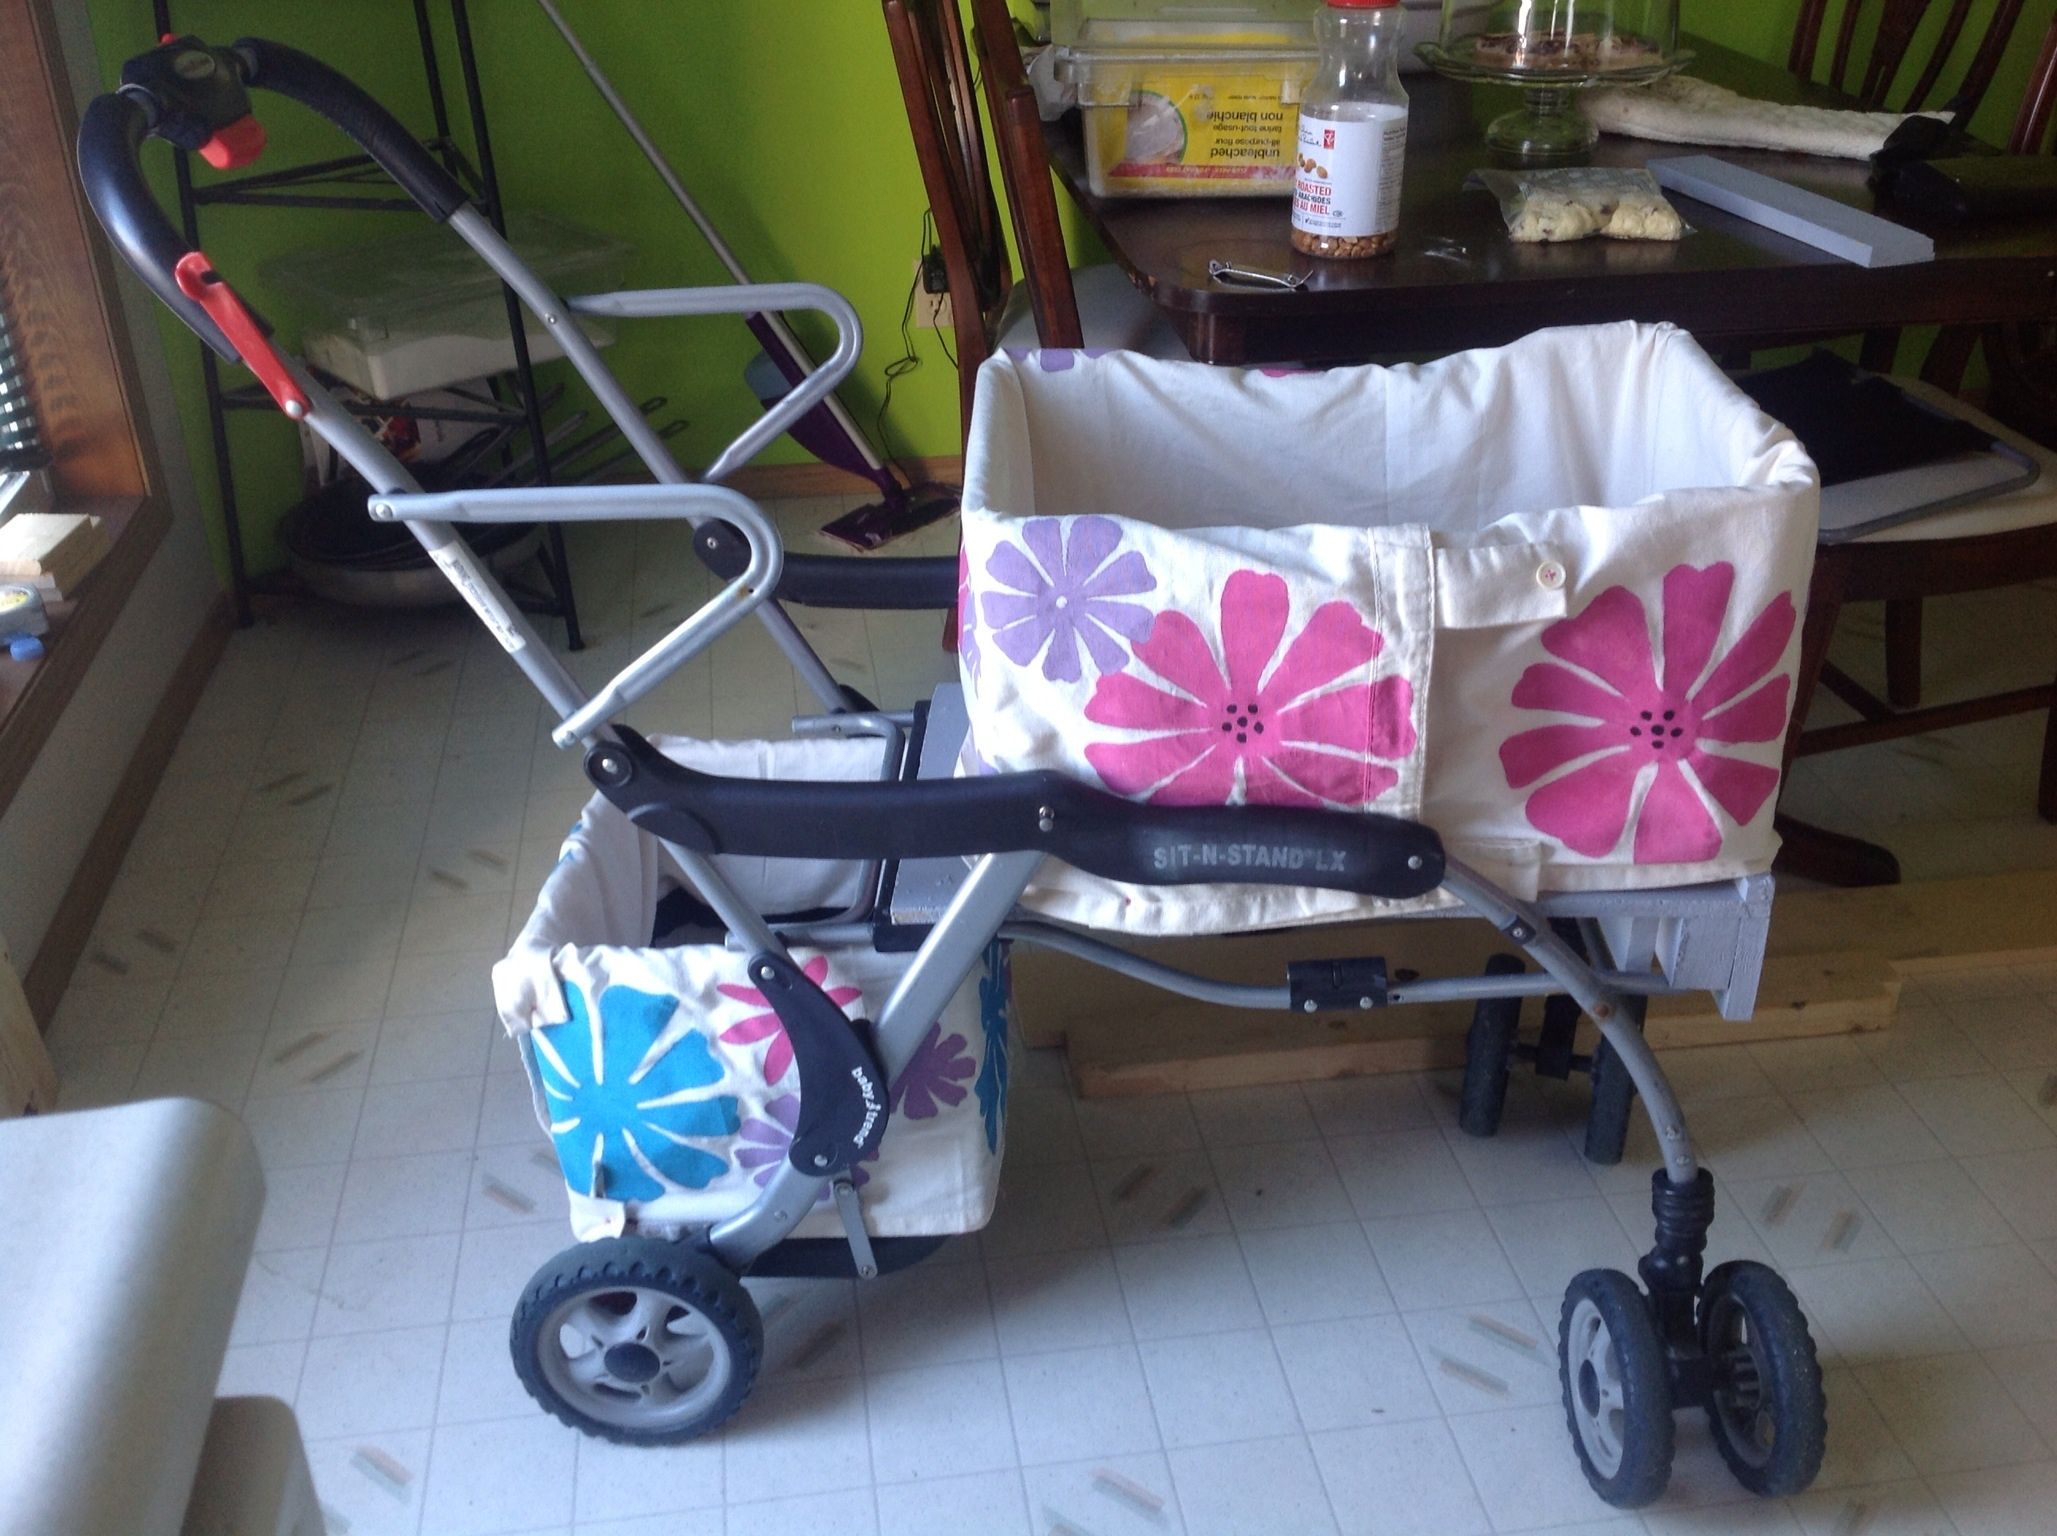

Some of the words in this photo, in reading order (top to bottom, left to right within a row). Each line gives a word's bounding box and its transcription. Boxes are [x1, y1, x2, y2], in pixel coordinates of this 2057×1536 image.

[1206, 111, 1258, 122] blanchie
[1260, 111, 1284, 121] non
[1210, 147, 1280, 159] unbleached
[1296, 180, 1332, 196] ROASTED
[1310, 203, 1330, 215] MIEL
[1153, 843, 1304, 871] SIT-N-STAND
[1315, 849, 1347, 872] LX
[850, 1066, 876, 1100] baby
[852, 1111, 879, 1150] trend
